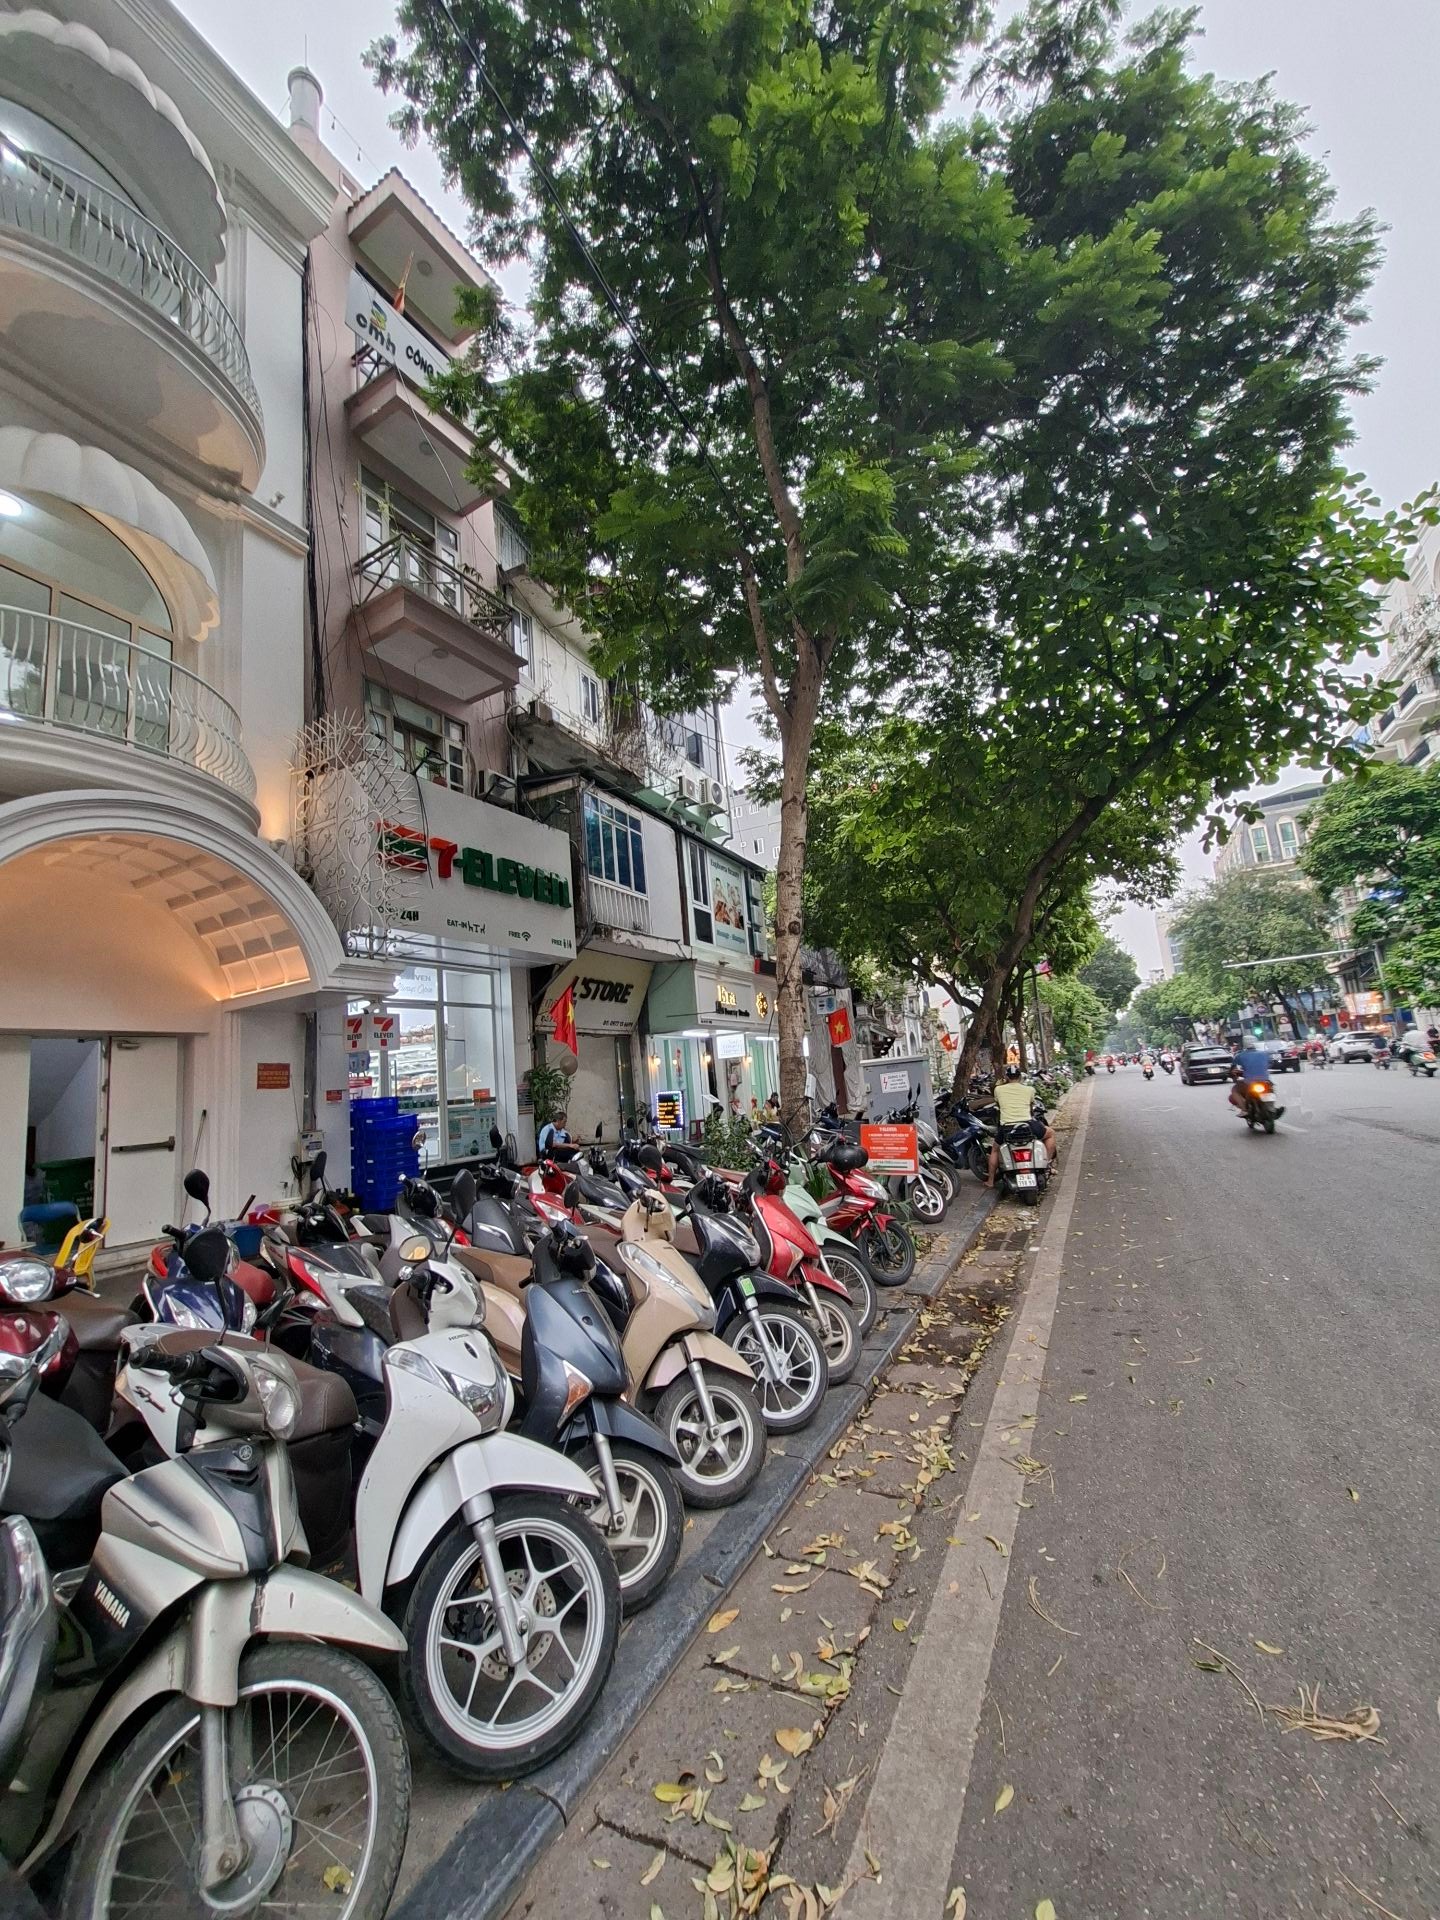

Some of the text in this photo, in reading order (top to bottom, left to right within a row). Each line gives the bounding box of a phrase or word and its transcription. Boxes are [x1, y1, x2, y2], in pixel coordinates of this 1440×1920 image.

[430, 837, 572, 909] 7-ELEVEN
[447, 919, 467, 928] EAT-IN
[552, 938, 562, 946] FREE
[94, 1580, 131, 1629] YAMAHA
